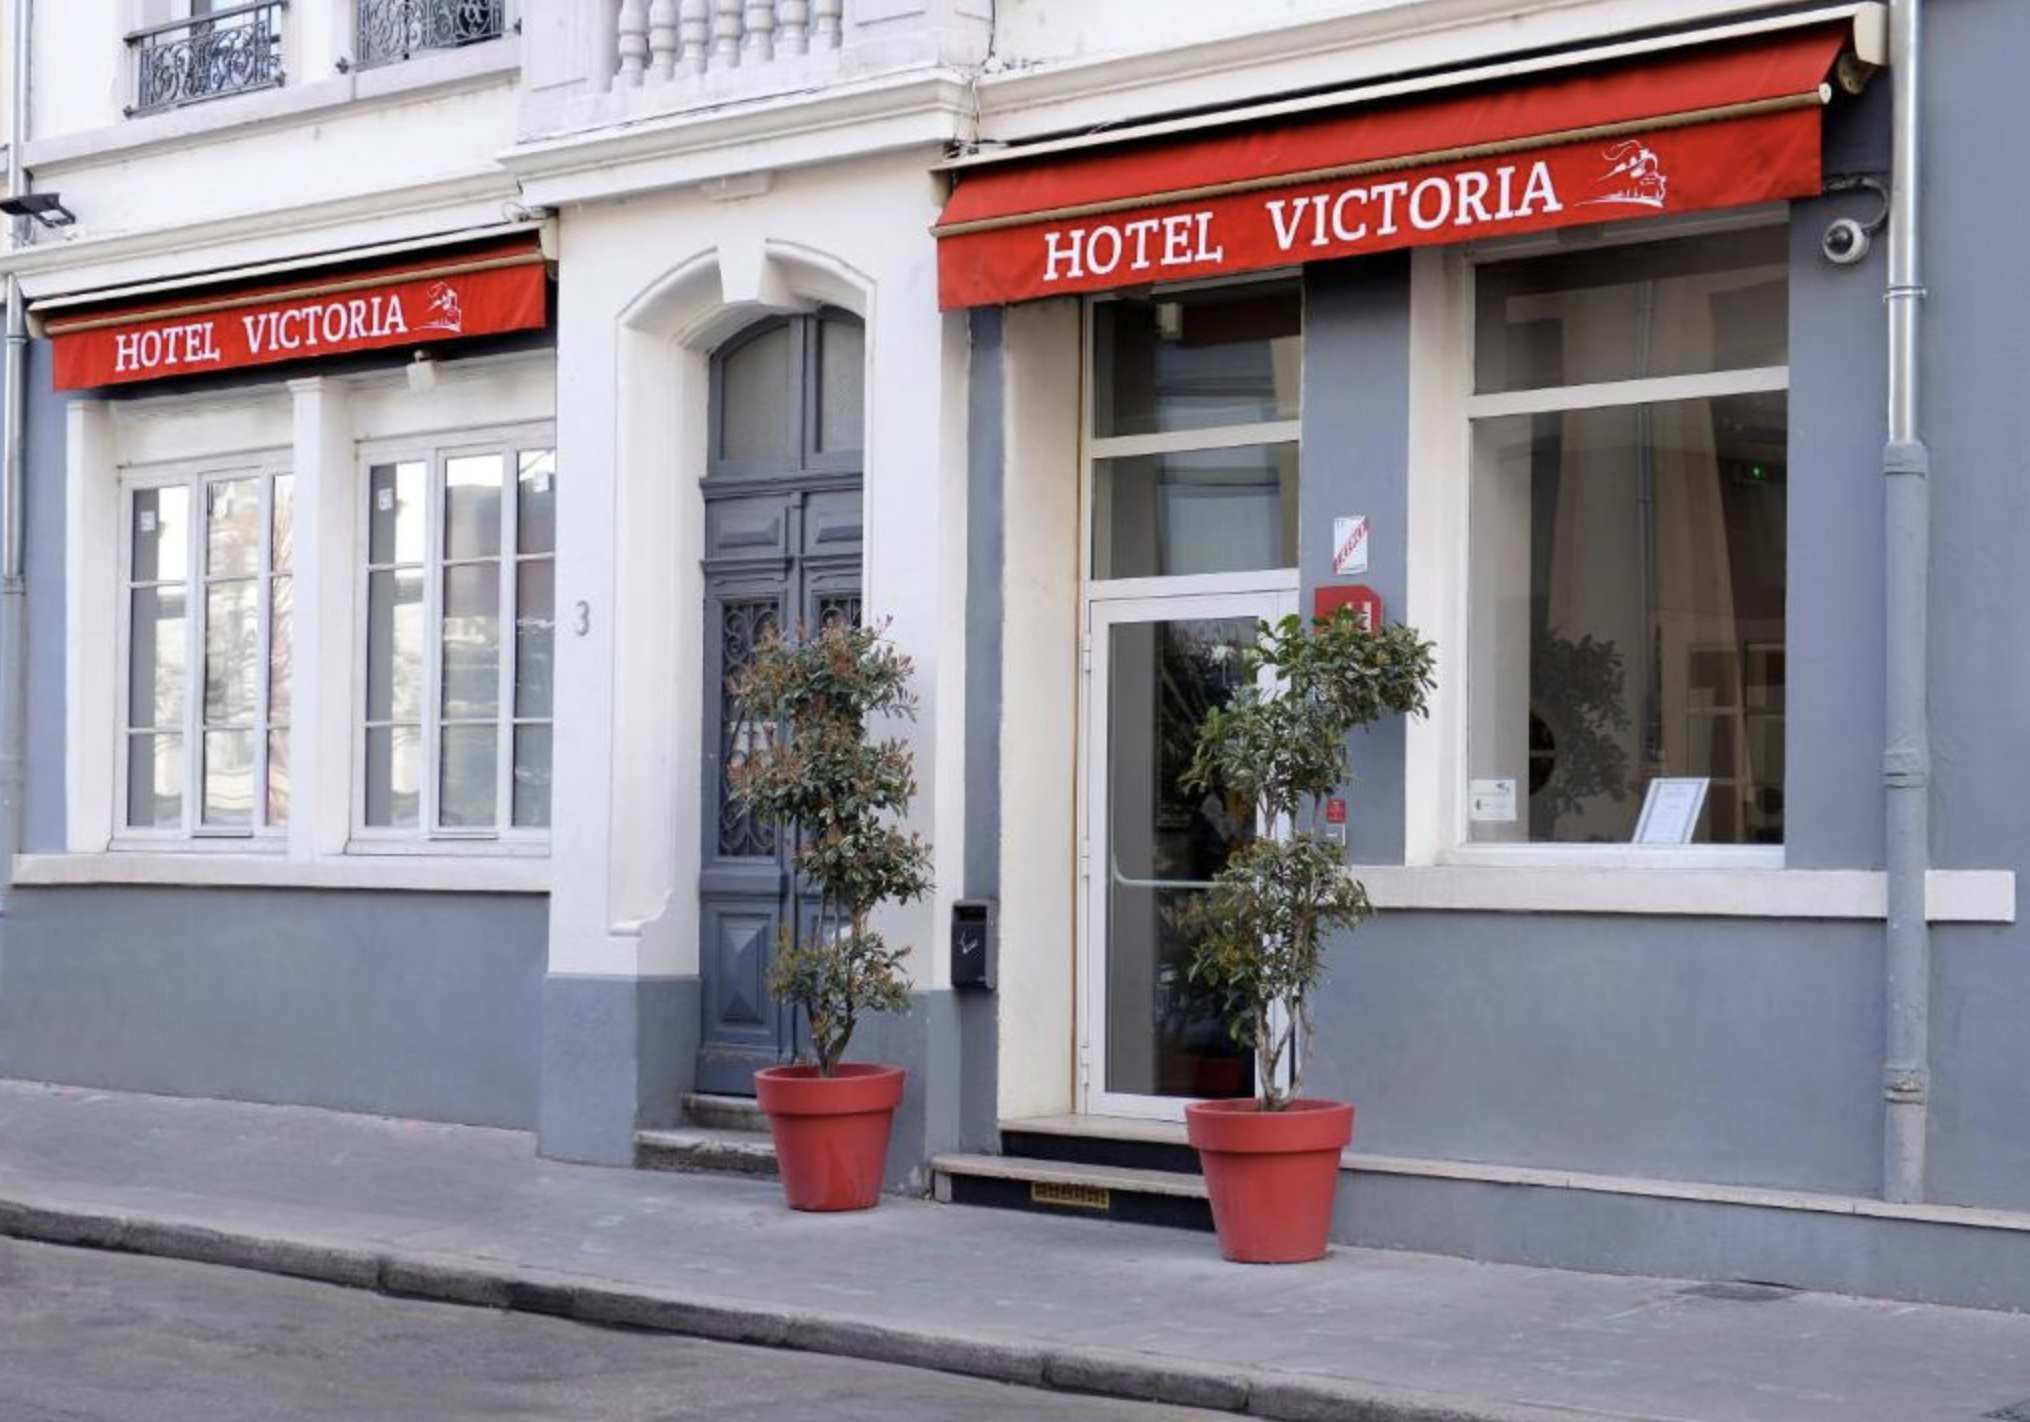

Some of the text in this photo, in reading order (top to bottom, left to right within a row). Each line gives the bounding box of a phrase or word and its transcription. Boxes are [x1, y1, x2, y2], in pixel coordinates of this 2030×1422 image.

[1043, 162, 1563, 281] HOTEL VICTORIA
[115, 295, 408, 371] HOTEL VICTORIA
[576, 600, 590, 637] 3
